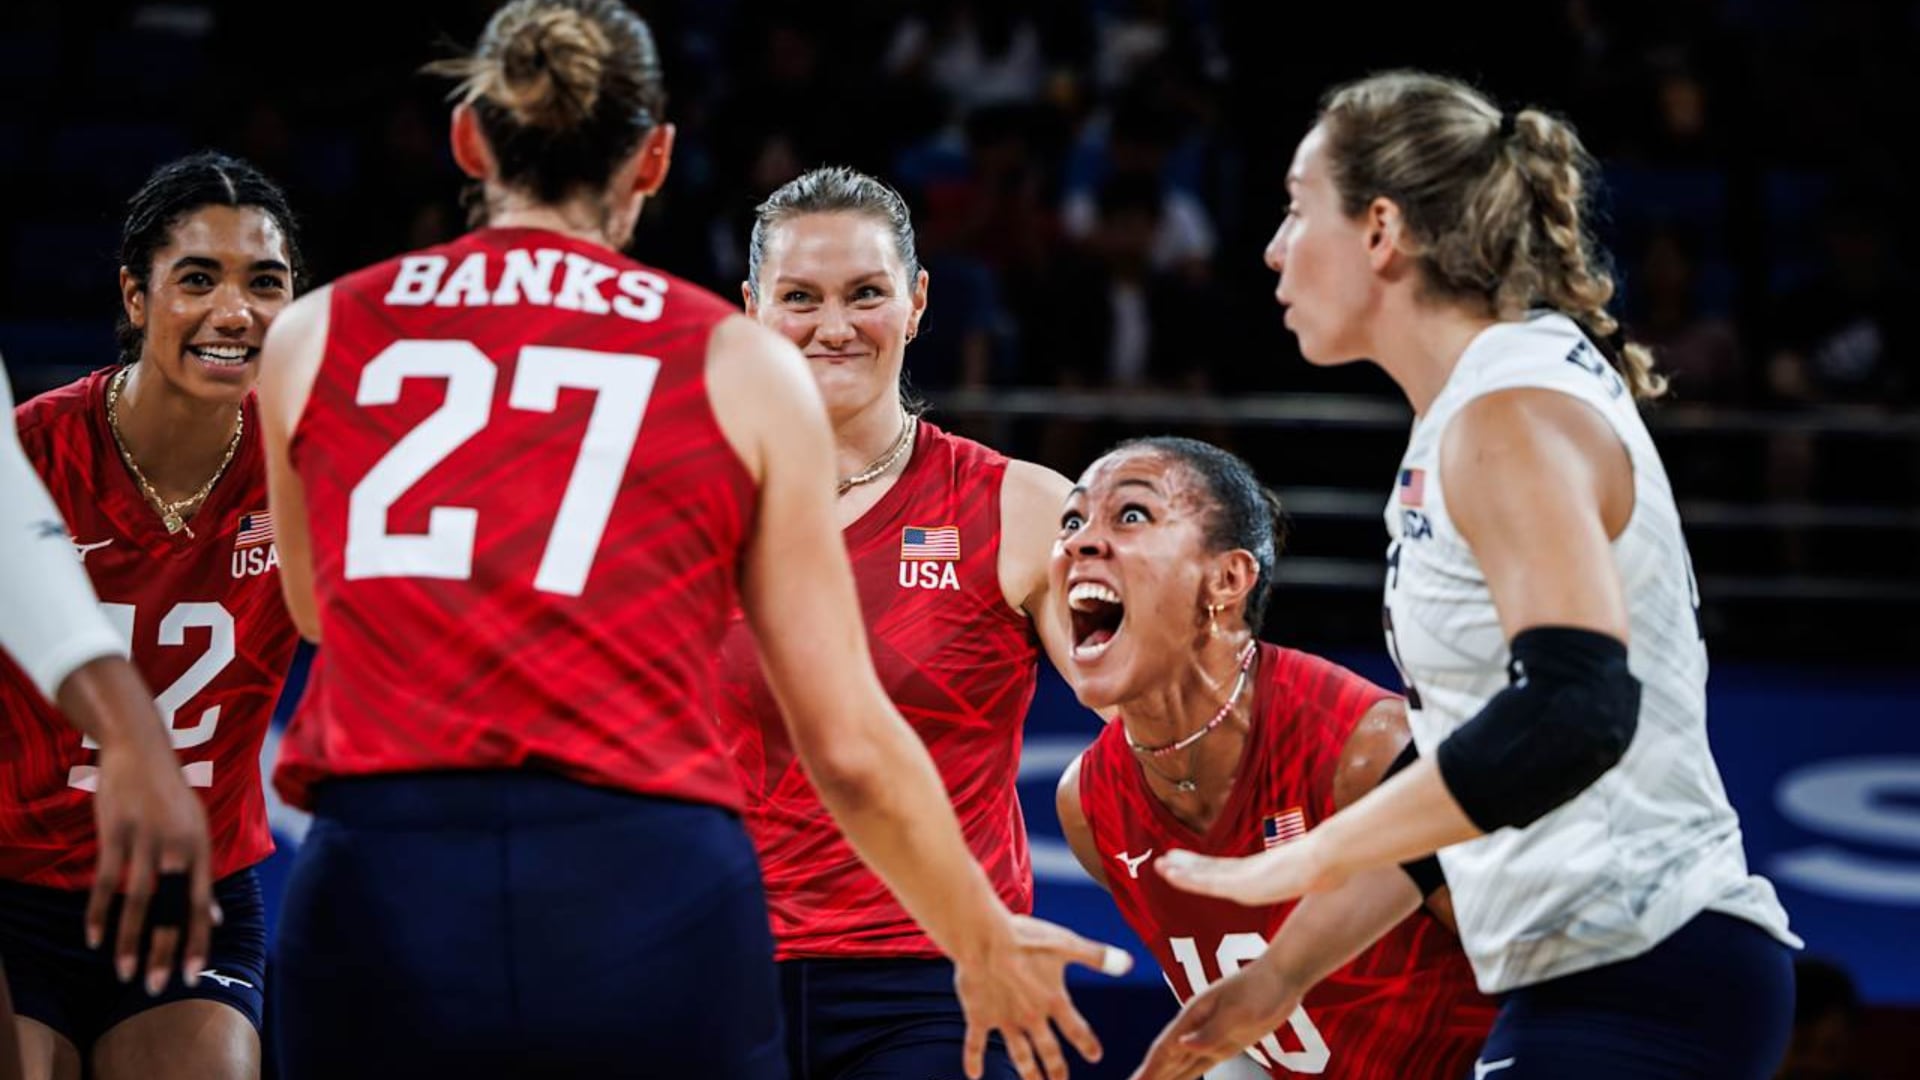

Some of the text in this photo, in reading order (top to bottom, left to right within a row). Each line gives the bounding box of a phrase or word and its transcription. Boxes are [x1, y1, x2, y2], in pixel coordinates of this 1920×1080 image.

[384, 248, 669, 323] BANKS
[344, 339, 662, 597] 27
[231, 544, 281, 578] USA
[899, 561, 960, 590] USA
